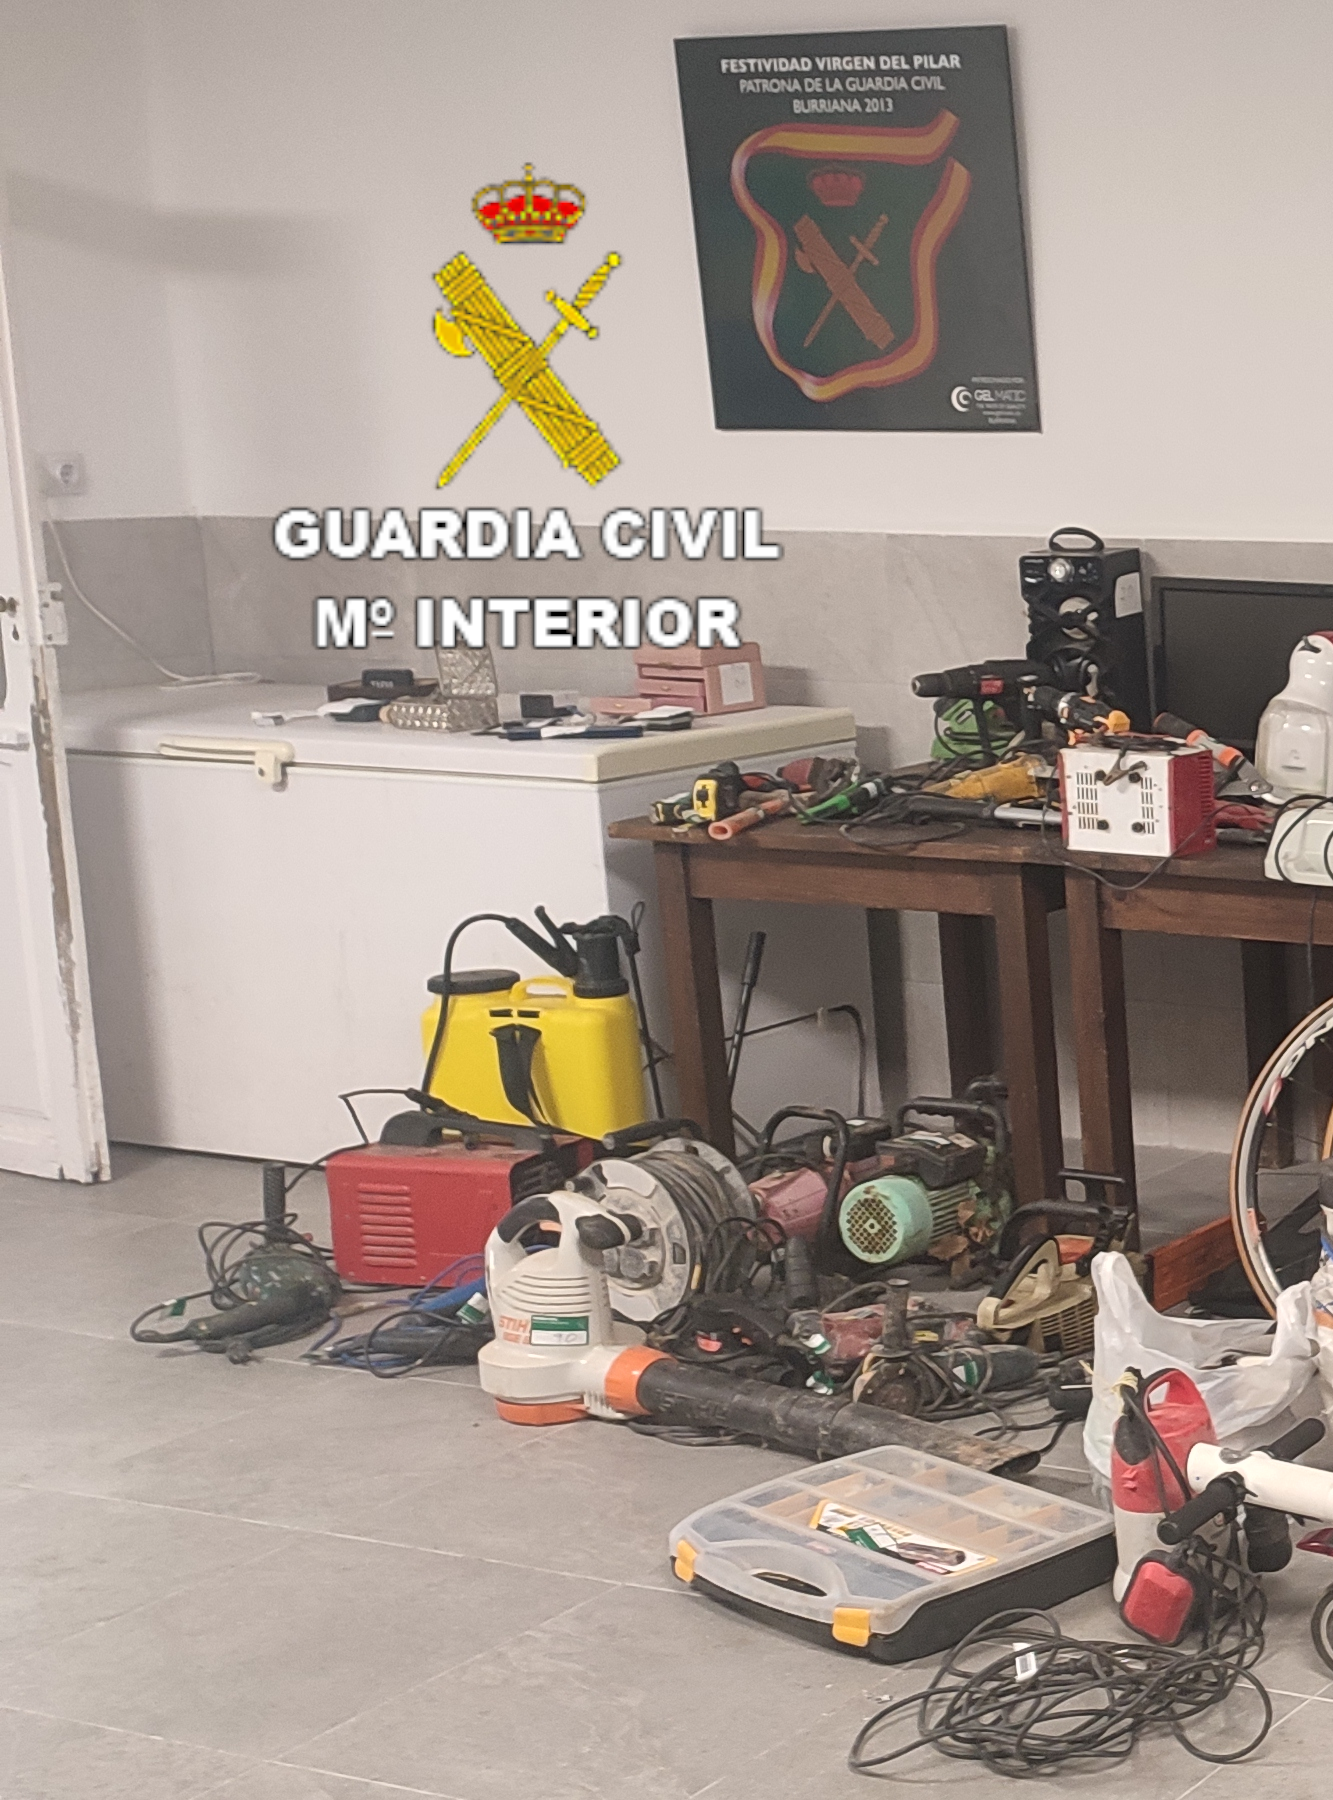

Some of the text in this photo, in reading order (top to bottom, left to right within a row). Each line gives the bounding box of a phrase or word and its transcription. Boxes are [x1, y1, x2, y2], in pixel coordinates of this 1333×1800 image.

[721, 54, 961, 73] FESTIVIDAD VIRGEN DEL PILAR
[739, 75, 945, 93] PATRONA DE LA GUARDIA CIVIL
[793, 97, 893, 113] BURRIANA 2013
